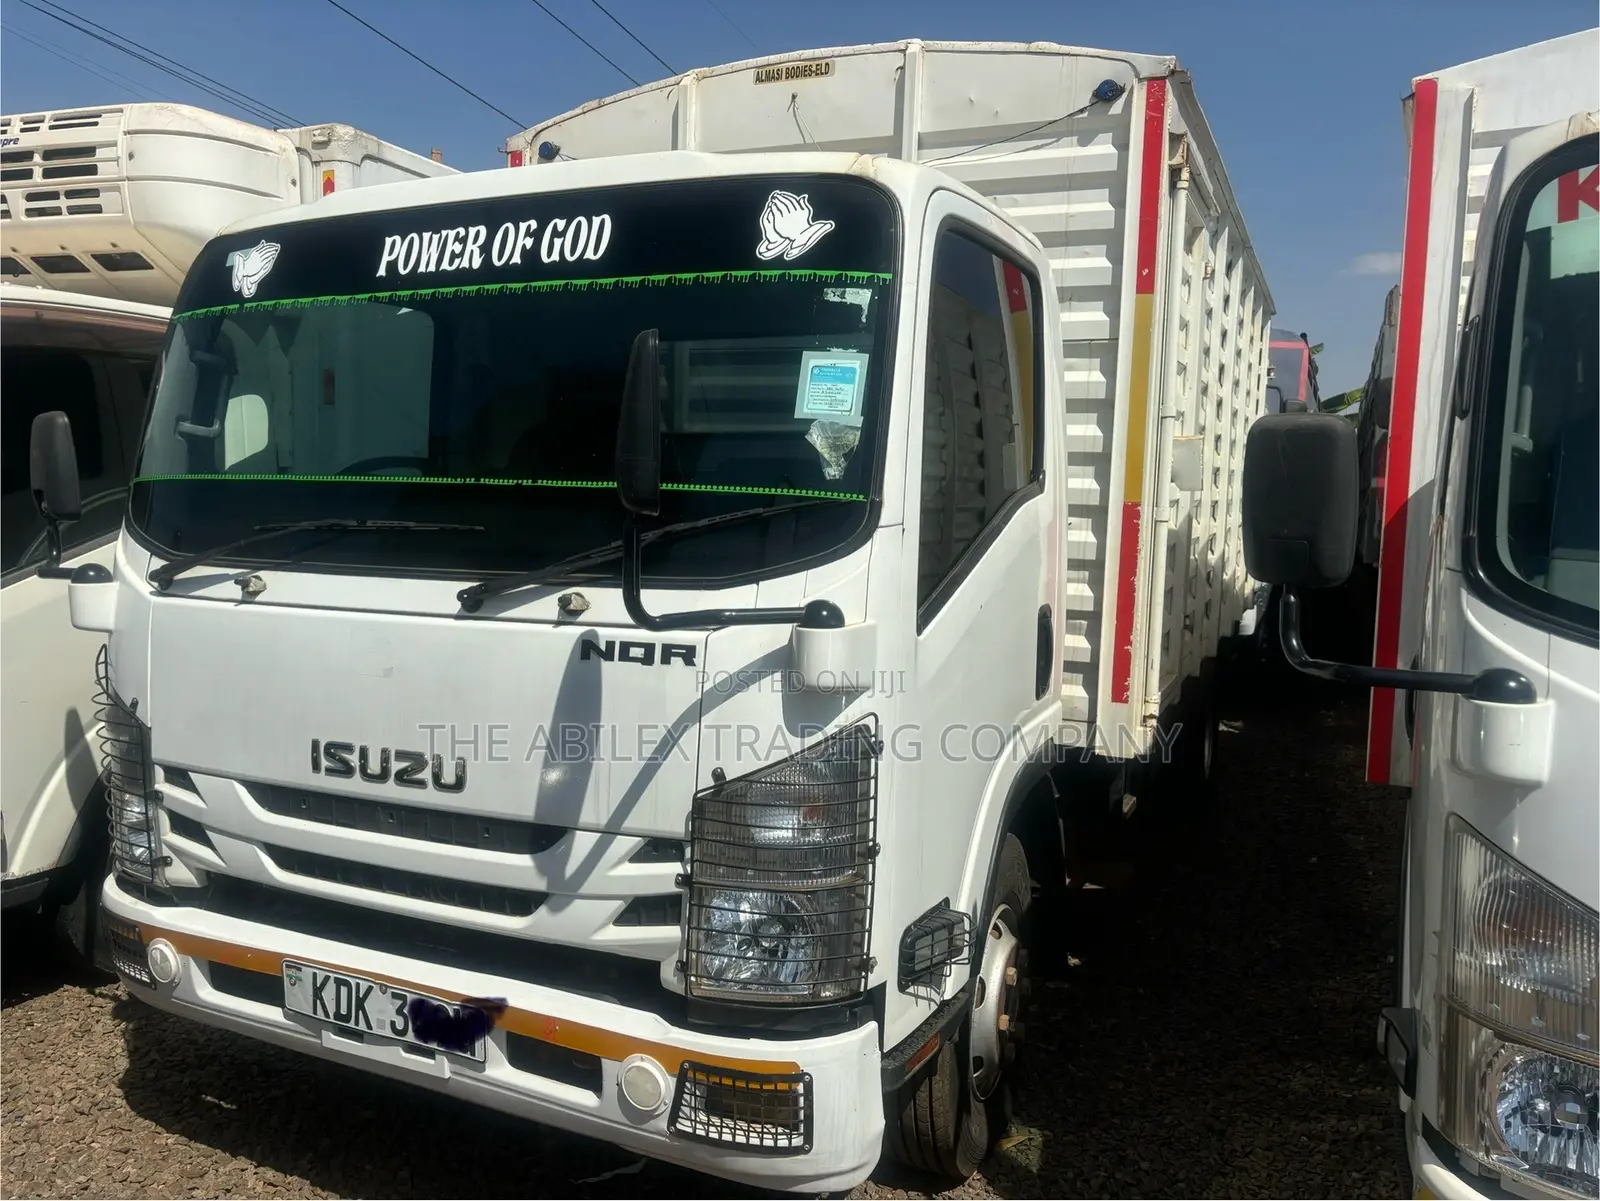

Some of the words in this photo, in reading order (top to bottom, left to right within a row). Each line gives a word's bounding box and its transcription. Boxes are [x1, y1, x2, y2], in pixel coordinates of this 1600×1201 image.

[755, 67, 783, 84] ALMASI
[785, 62, 830, 80] BODIES-ELD
[376, 225, 487, 277] POWER
[491, 219, 537, 267] OF
[540, 213, 612, 264] GOD
[580, 639, 697, 667] NQR
[310, 738, 468, 794] ISUZU
[312, 971, 374, 1031] KDK
